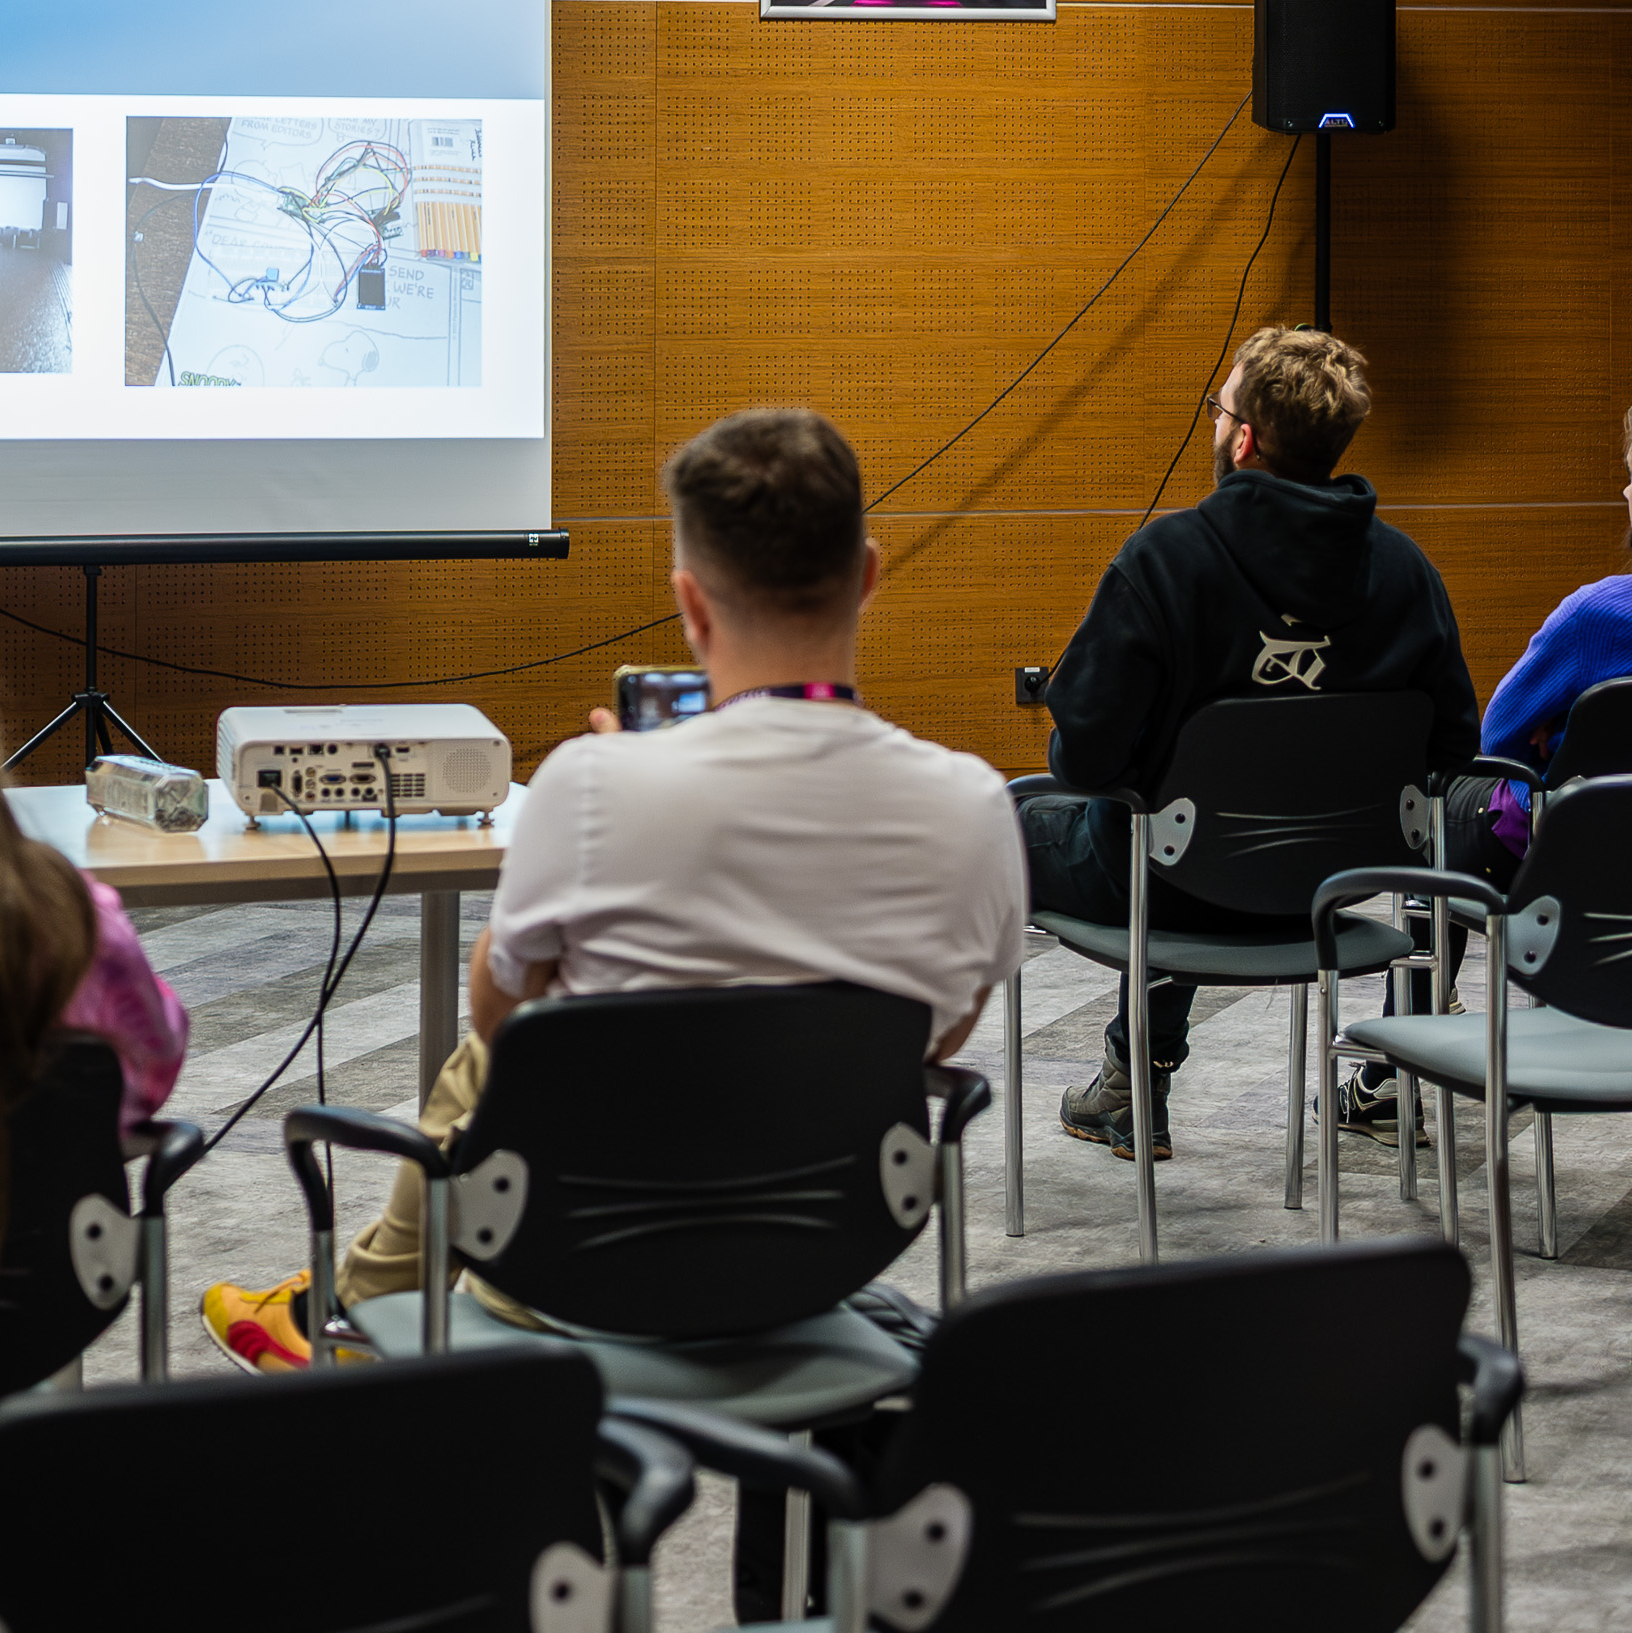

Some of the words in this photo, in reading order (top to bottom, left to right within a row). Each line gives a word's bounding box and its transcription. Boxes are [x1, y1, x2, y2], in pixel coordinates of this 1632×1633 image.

[240, 119, 269, 131] FROM
[271, 124, 312, 139] EDITORS
[388, 264, 425, 281] SEND
[393, 280, 434, 300] WE'RE
